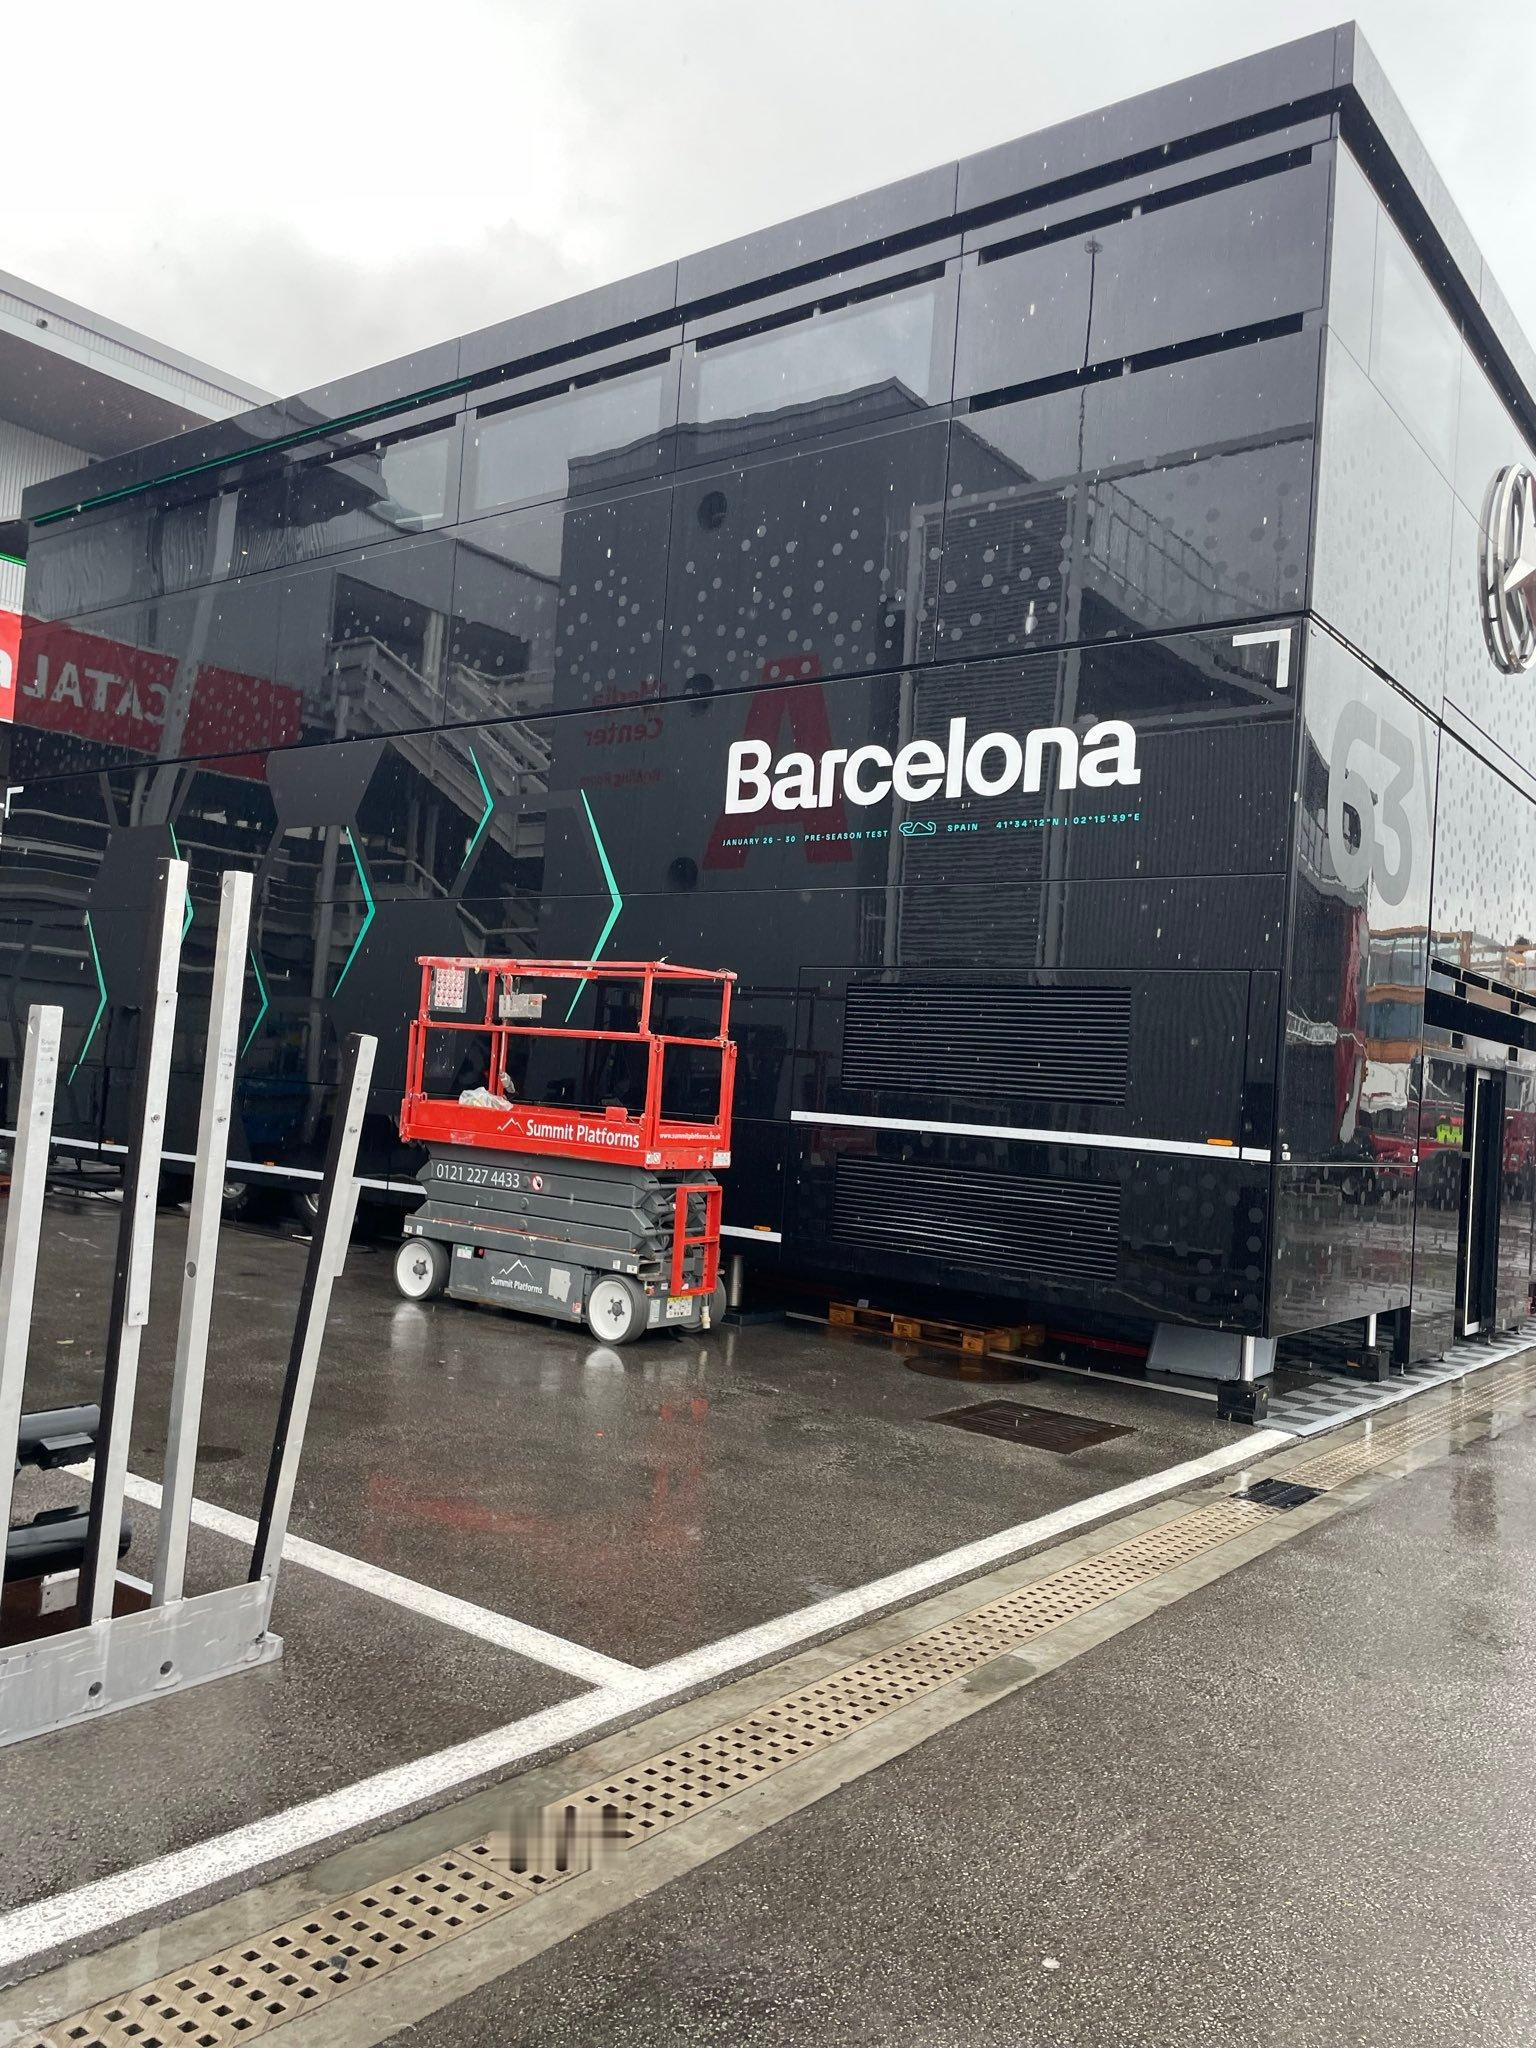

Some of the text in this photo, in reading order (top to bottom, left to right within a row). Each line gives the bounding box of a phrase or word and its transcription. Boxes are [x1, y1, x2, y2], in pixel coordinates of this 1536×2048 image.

[724, 717, 1142, 815] Barcelona
[1327, 699, 1415, 907] 63
[722, 837, 759, 847] JANUARY
[762, 836, 774, 844] 26
[804, 831, 862, 842] PRE-SEASON
[865, 830, 889, 839] TEST
[947, 822, 978, 832] SPAIN
[526, 1119, 640, 1149] Summit Platforms
[436, 1163, 520, 1189] 0121 227 4433
[490, 1275, 543, 1294] Summit Platforms
